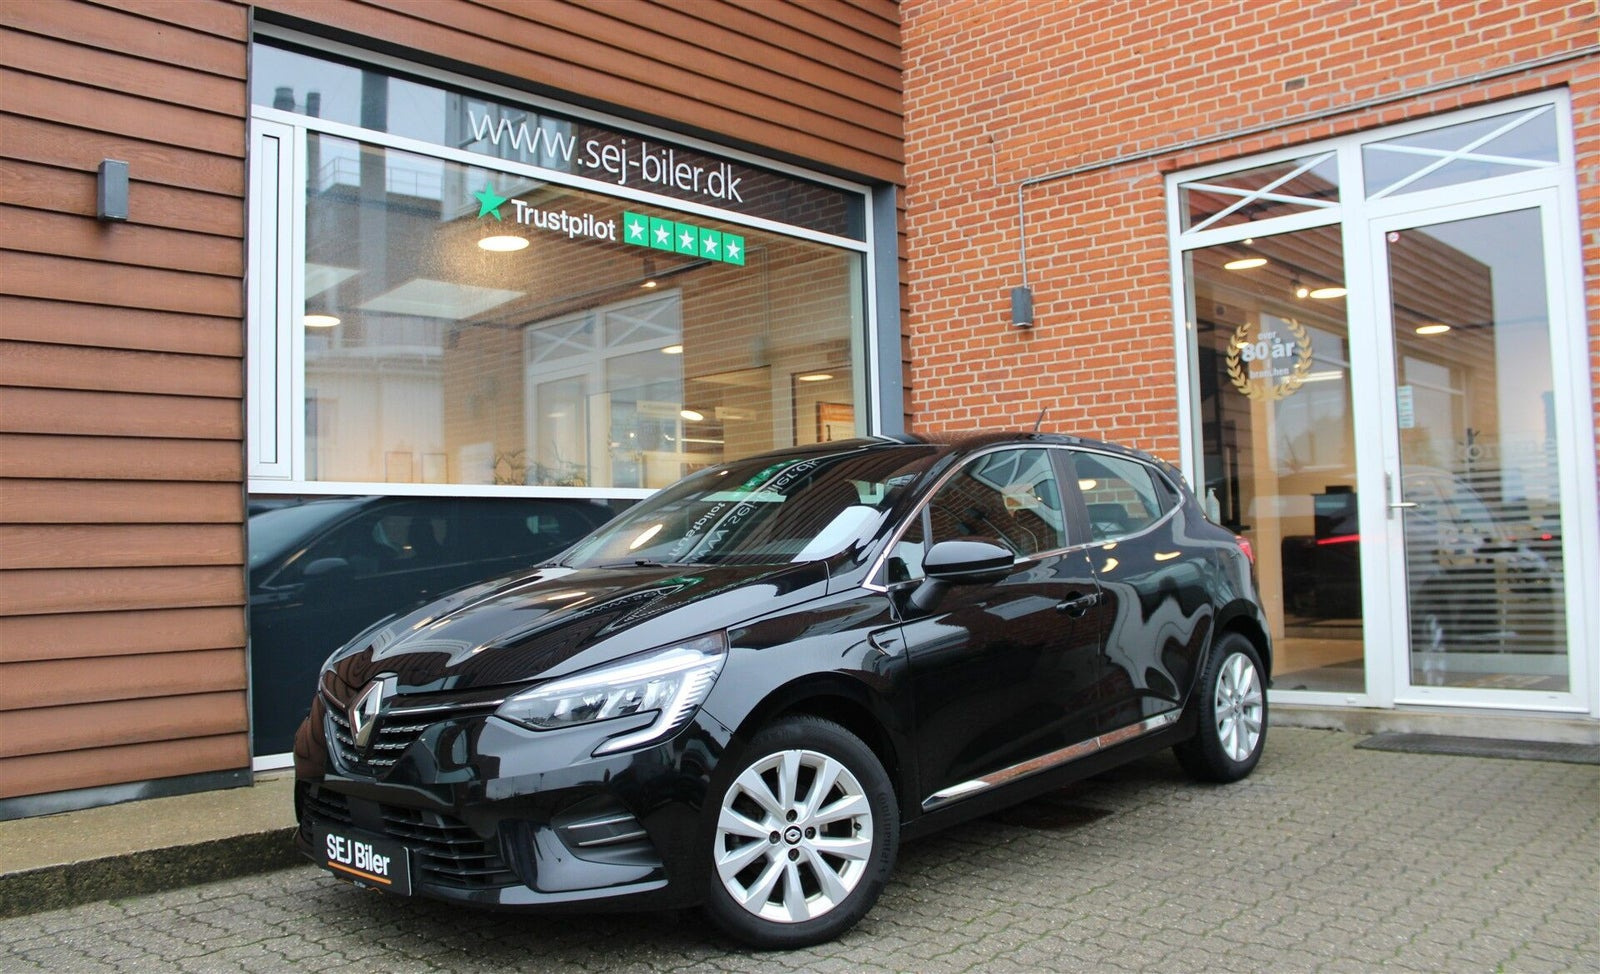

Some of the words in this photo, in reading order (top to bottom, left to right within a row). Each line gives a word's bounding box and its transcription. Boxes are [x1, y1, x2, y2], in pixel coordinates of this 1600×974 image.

[469, 110, 743, 203] www.sej-biler.dk
[511, 198, 616, 241] Trustpilot
[1242, 341, 1268, 362] 80
[1271, 338, 1295, 358] år
[326, 833, 352, 865] SEJ
[354, 841, 391, 876] Biler
